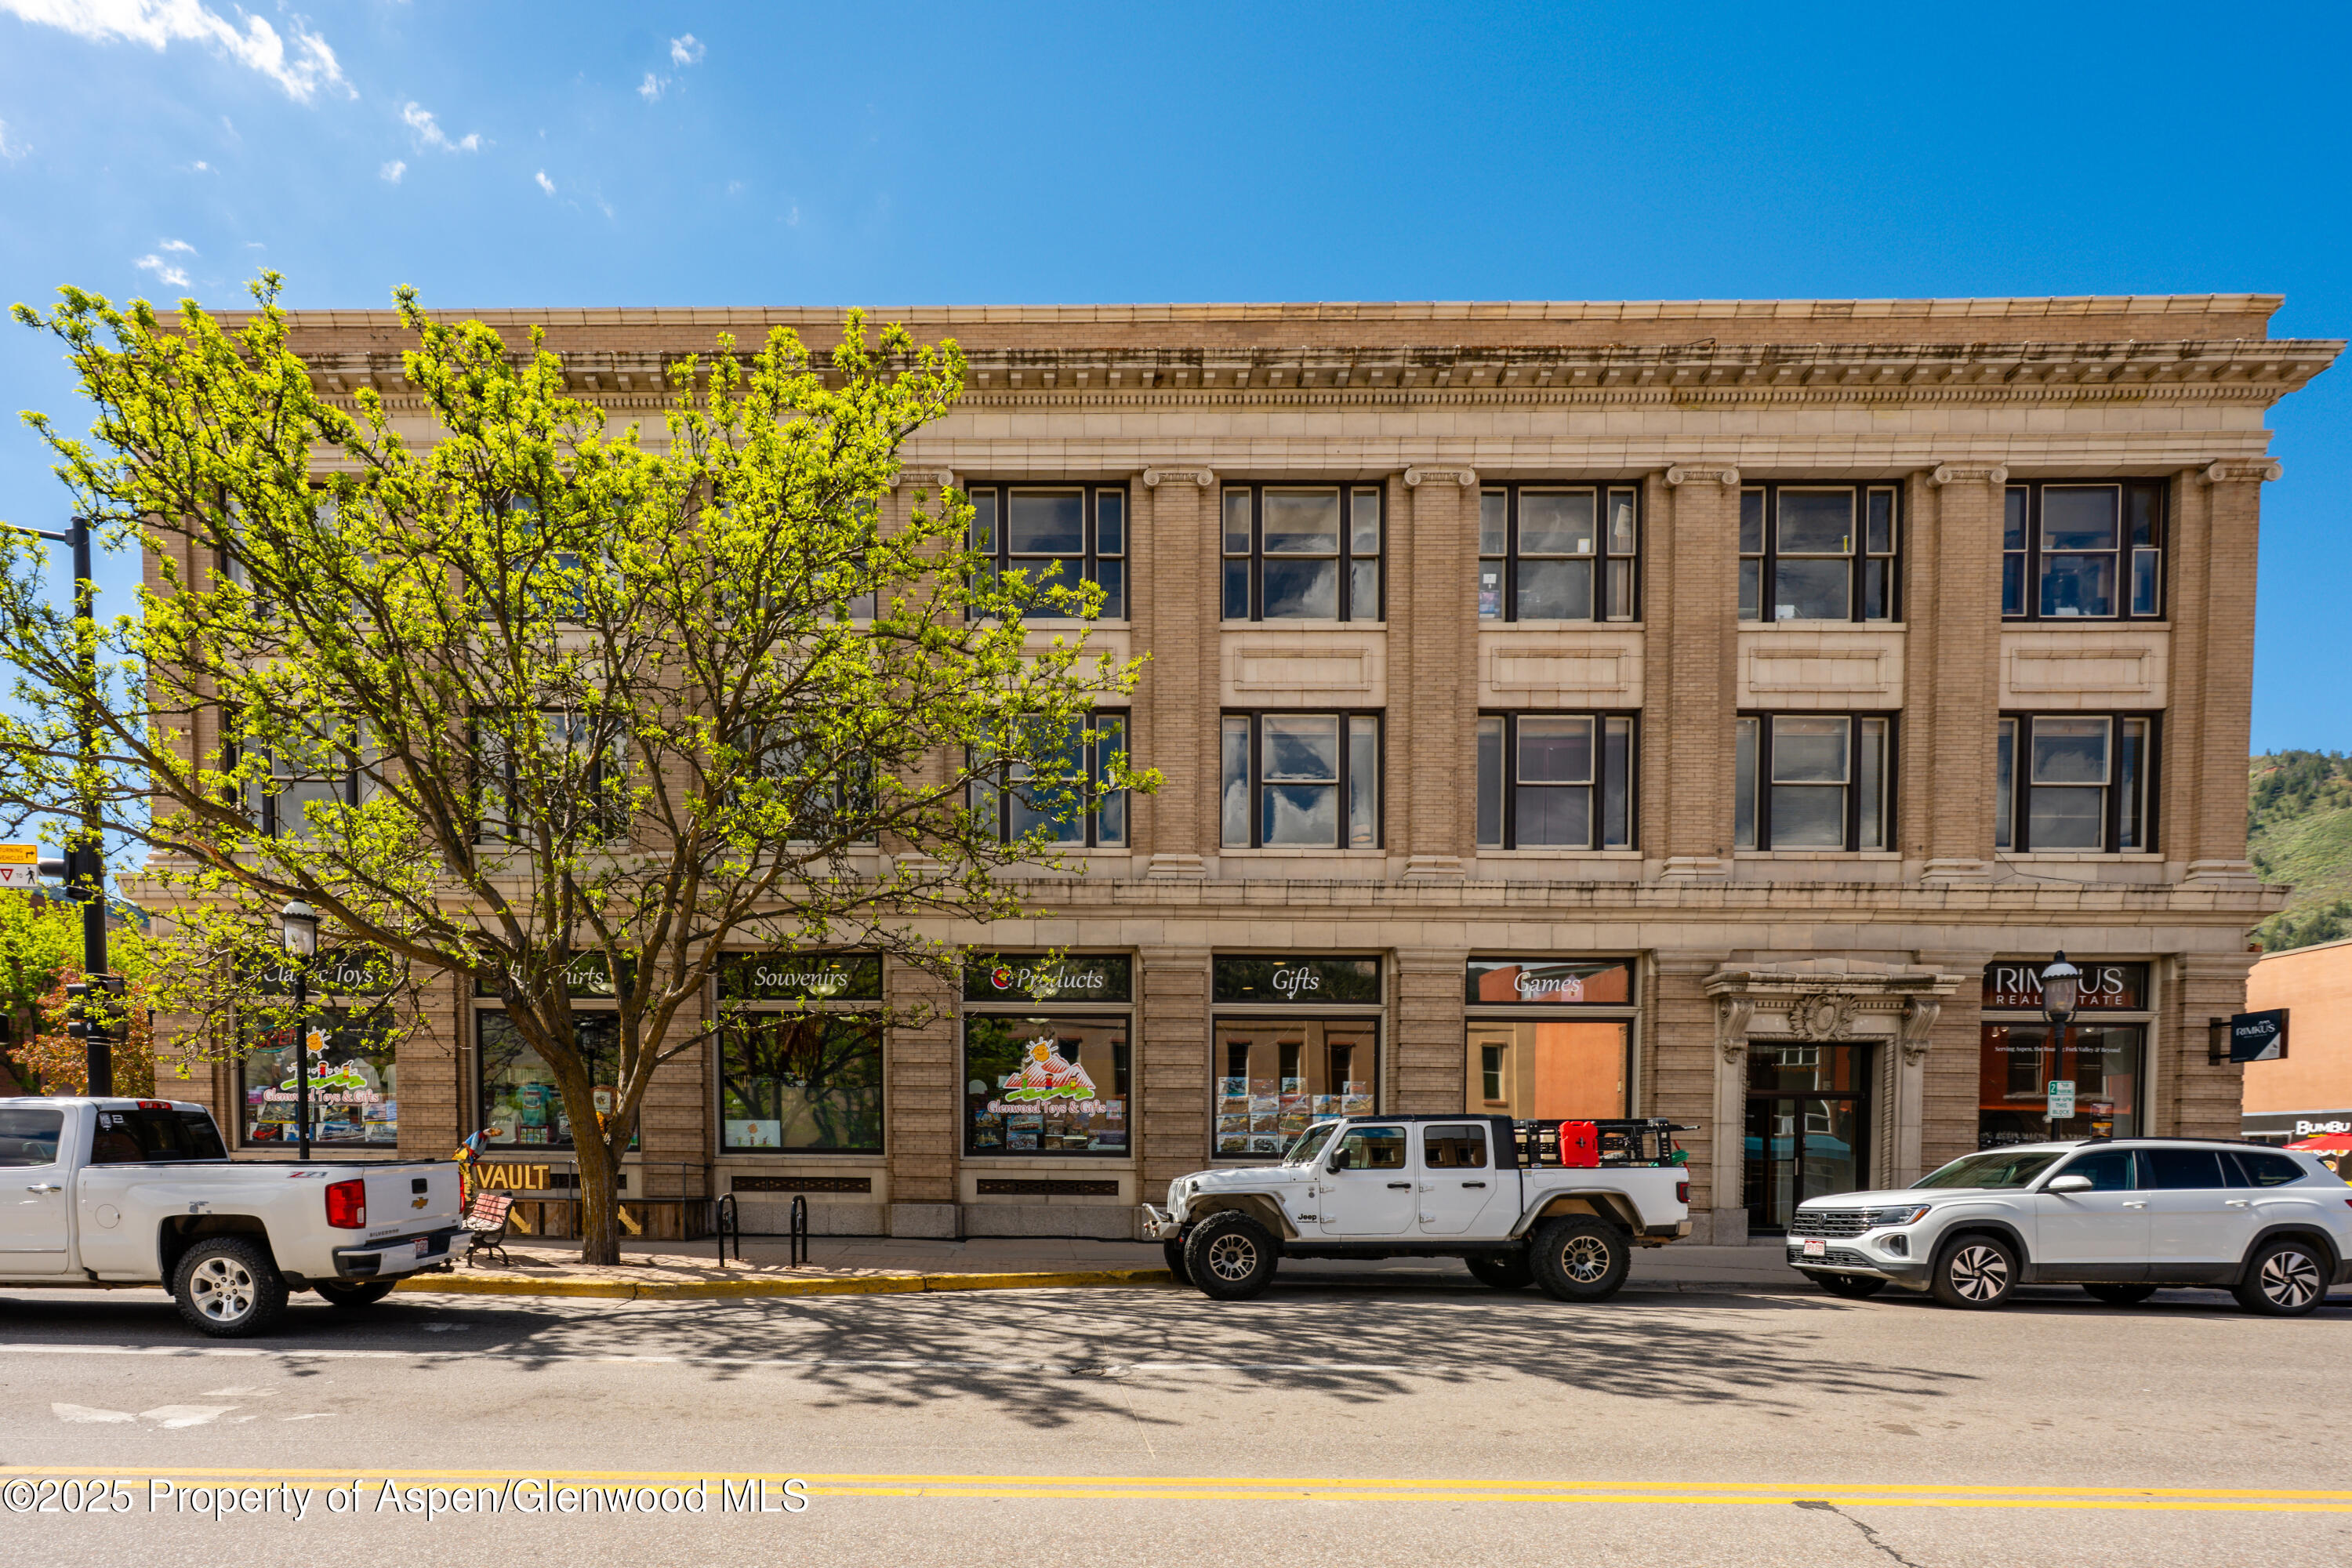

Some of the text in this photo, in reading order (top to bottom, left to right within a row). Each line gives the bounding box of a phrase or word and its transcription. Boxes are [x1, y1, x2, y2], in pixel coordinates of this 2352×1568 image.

[336, 963, 374, 989] Toys
[754, 966, 848, 986] Souvenirs
[1016, 965, 1104, 989] Products
[1272, 967, 1319, 998] Gifts
[1513, 971, 1581, 993] Games
[1997, 967, 2124, 994] RIMUS
[1996, 995, 2042, 1004] REAL
[2235, 1023, 2276, 1036] RIMKUS
[316, 1089, 340, 1105] Toys
[342, 1090, 352, 1102] &
[353, 1088, 379, 1106] Gifts
[2050, 1083, 2056, 1093] 2
[988, 1100, 1106, 1117] Glenwood Toys & Gifts
[476, 1164, 549, 1190] VAULT
